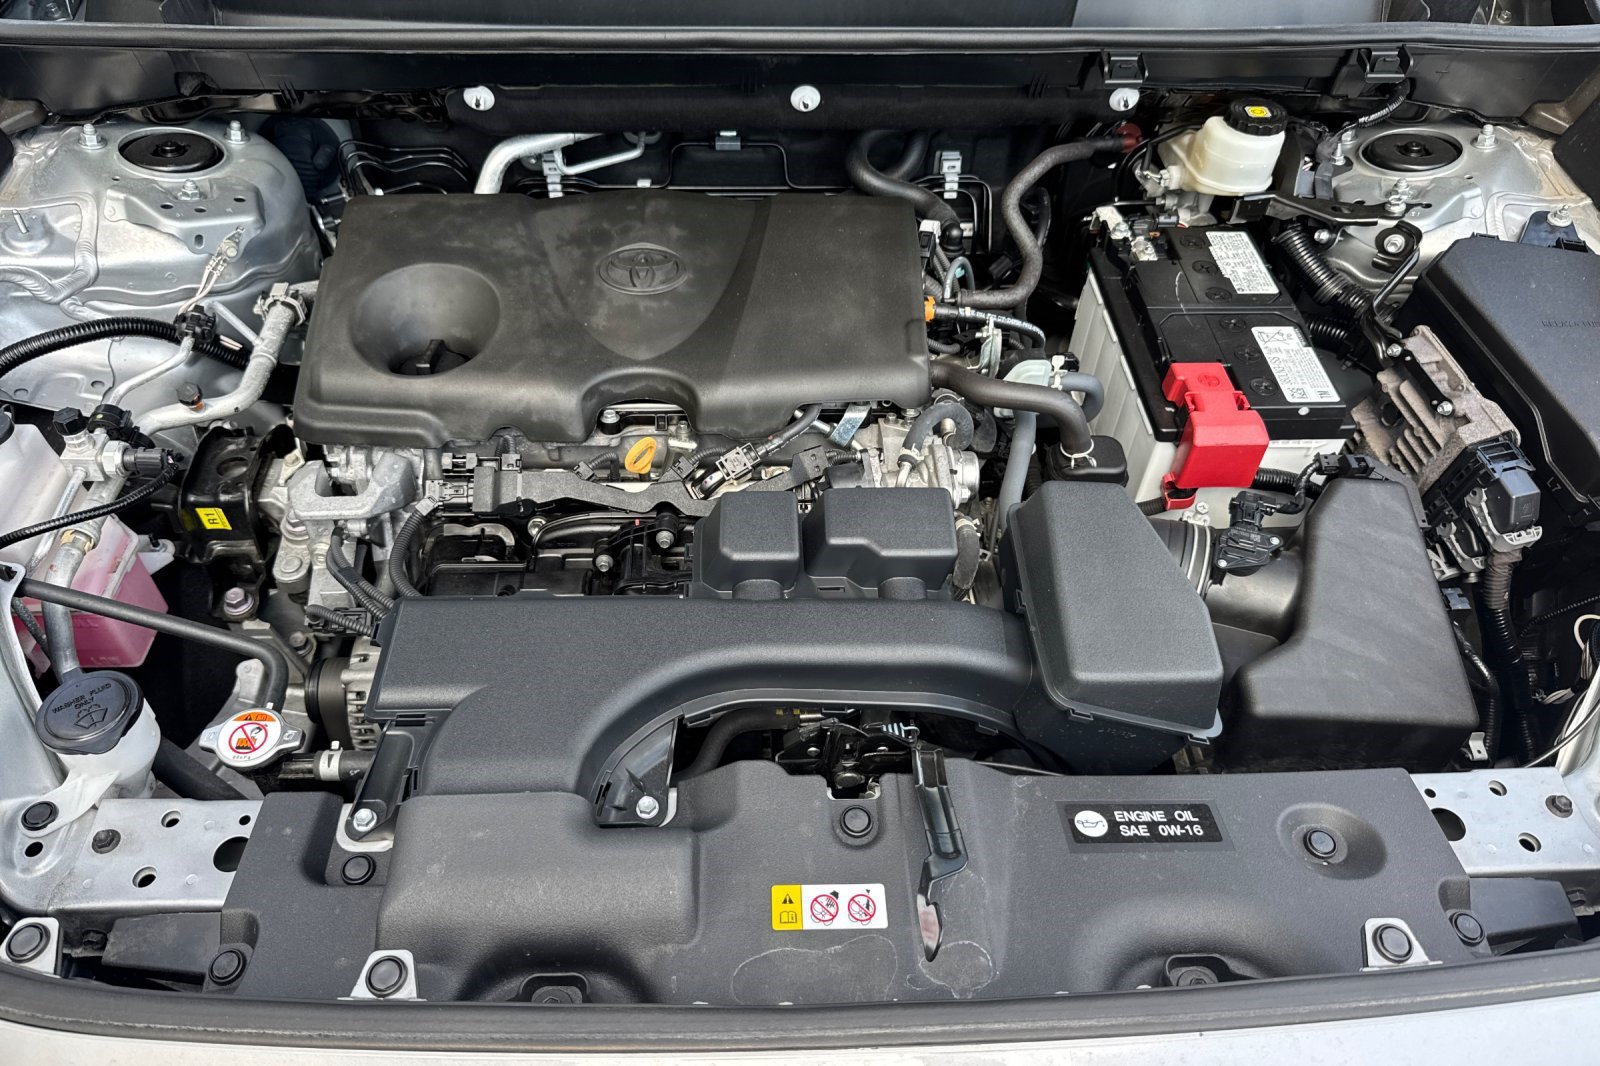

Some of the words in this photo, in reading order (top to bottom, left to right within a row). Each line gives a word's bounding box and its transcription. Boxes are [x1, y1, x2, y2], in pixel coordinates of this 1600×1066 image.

[203, 513, 220, 525] R1
[52, 694, 86, 714] WASHER
[89, 683, 112, 696] FLUID
[74, 696, 94, 709] ONLY
[1113, 810, 1167, 822] ENGINE
[1174, 810, 1199, 822] OIL
[1119, 824, 1150, 836] SAE
[1158, 824, 1204, 836] 0W-16
